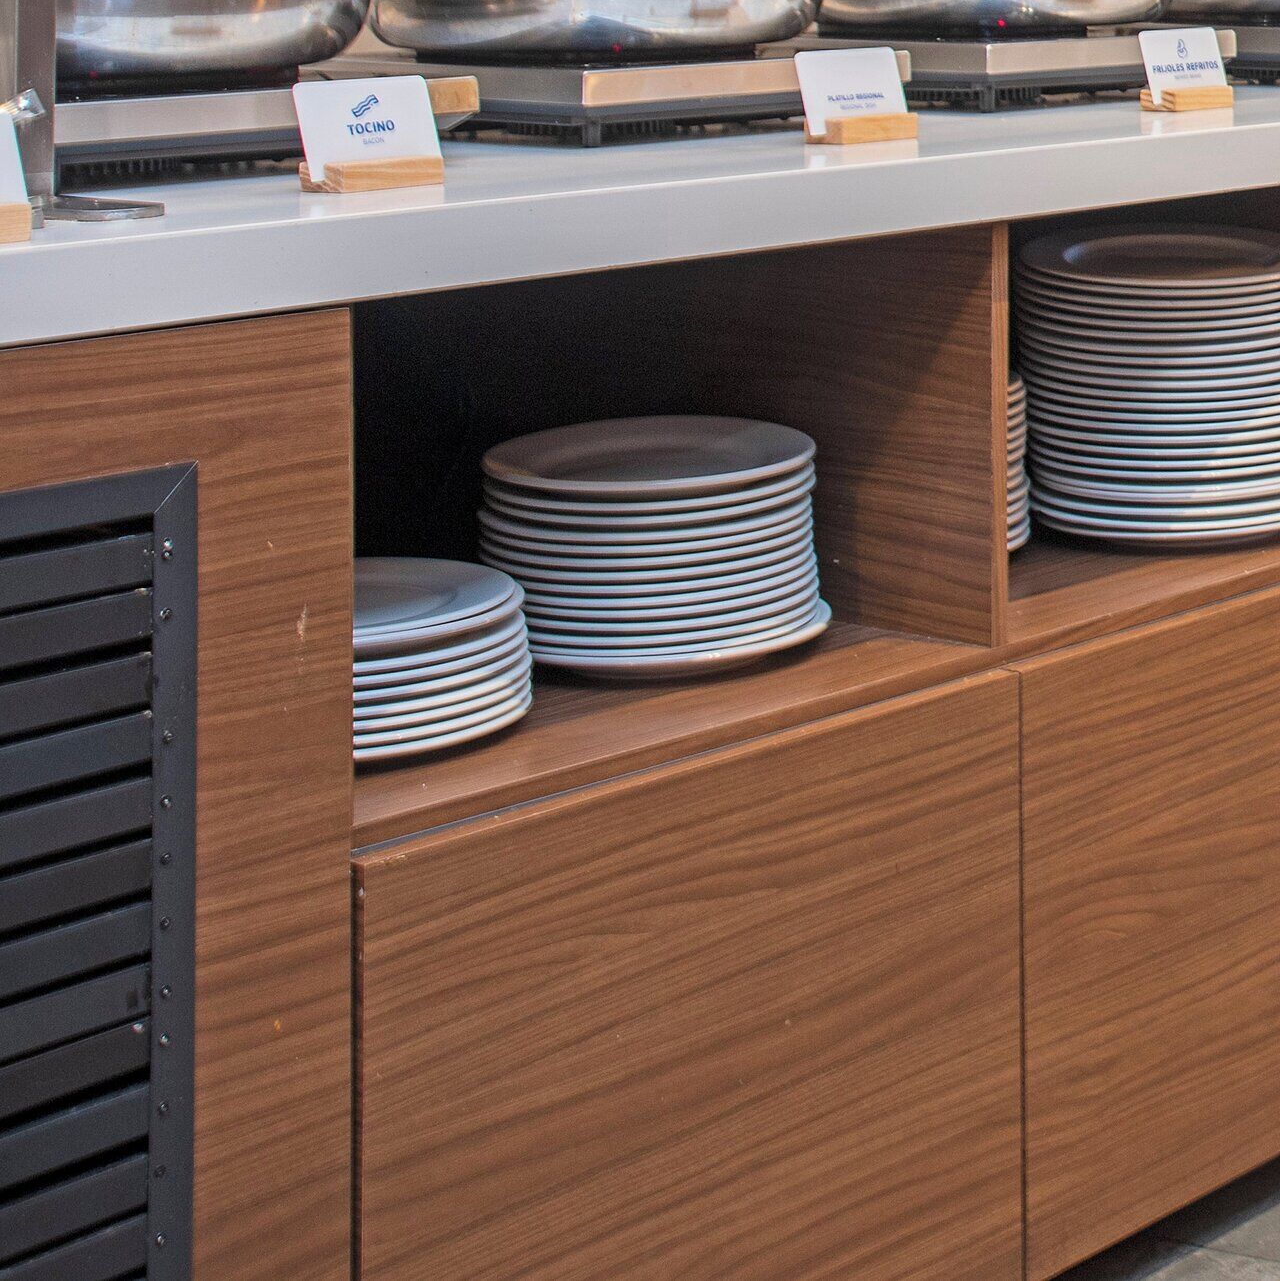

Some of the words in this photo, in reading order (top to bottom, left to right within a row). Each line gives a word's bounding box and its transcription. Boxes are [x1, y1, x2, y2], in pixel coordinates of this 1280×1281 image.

[1152, 62, 1185, 74] FRIJOLES
[1186, 60, 1219, 71] REFRITOS
[346, 119, 395, 136] TOCINO
